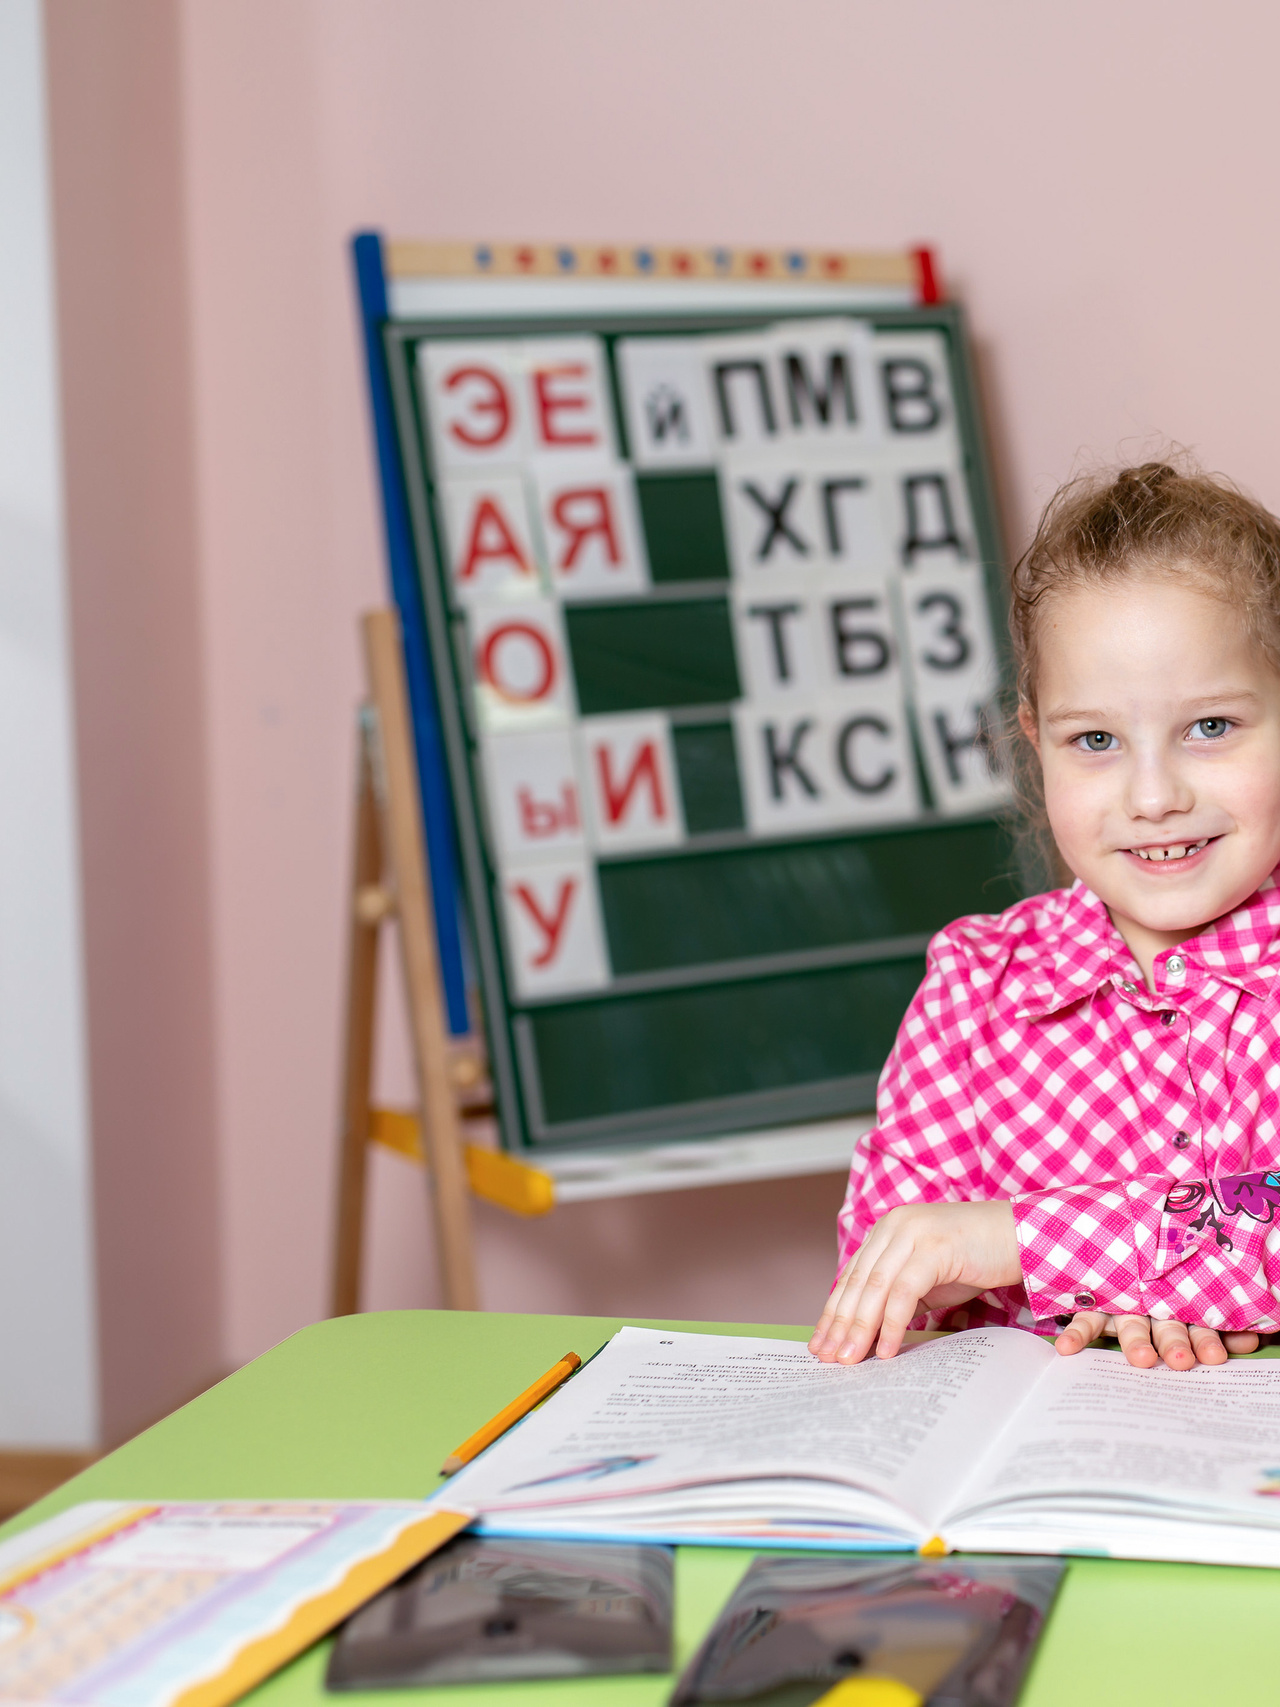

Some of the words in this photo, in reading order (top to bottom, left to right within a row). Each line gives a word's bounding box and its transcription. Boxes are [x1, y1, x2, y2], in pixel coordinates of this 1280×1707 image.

[443, 366, 514, 450] Э
[531, 365, 598, 448] Е
[710, 357, 779, 440] П
[782, 349, 859, 428] М
[881, 356, 943, 434] В
[458, 497, 532, 582] А
[551, 487, 623, 571] Я
[741, 478, 809, 562] Х
[819, 477, 866, 557] Г
[901, 473, 969, 568] Д
[746, 604, 800, 687] Т
[830, 598, 892, 679] Б
[595, 739, 667, 827] И
[762, 720, 820, 803] К
[834, 714, 898, 797] С
[513, 877, 576, 968] У
